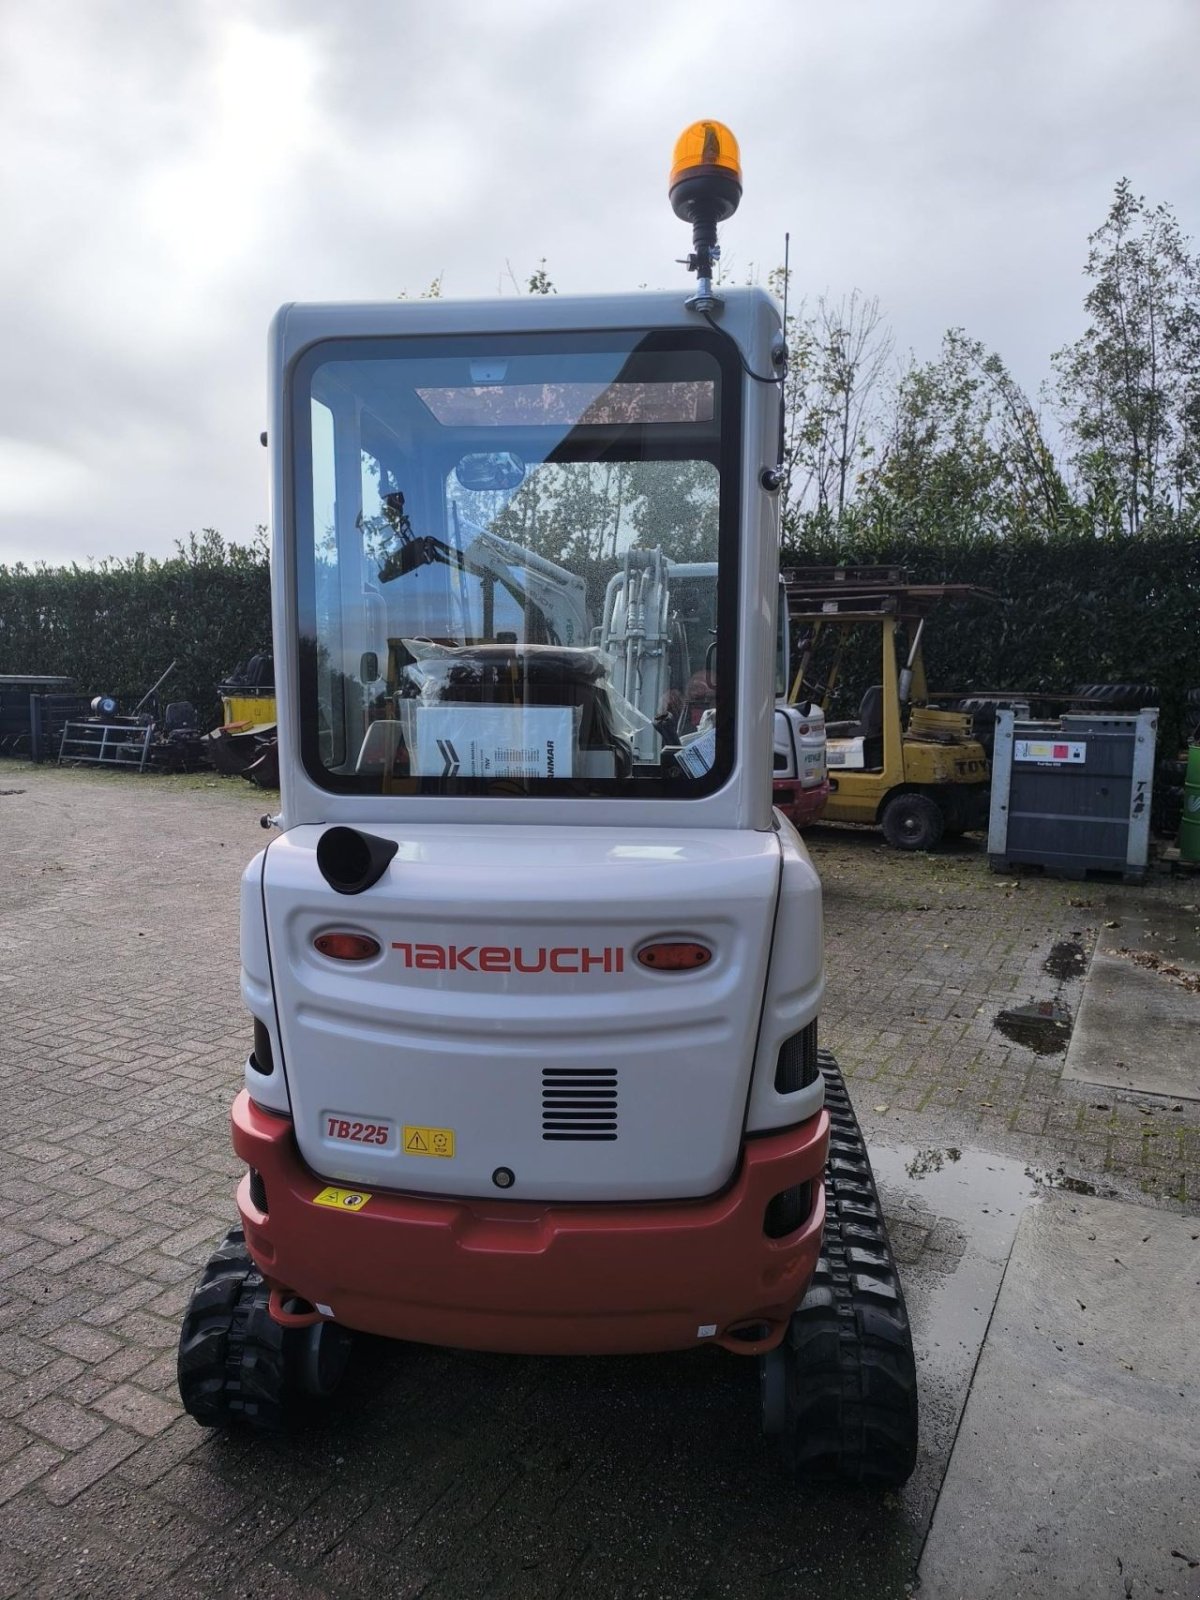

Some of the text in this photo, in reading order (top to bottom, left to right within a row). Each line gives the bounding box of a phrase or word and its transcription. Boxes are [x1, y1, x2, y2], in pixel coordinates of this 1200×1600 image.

[547, 740, 555, 777] ANMAR
[955, 760, 985, 773] TOY
[391, 942, 624, 973] TAKEUCHI
[327, 1118, 389, 1145] TB225
